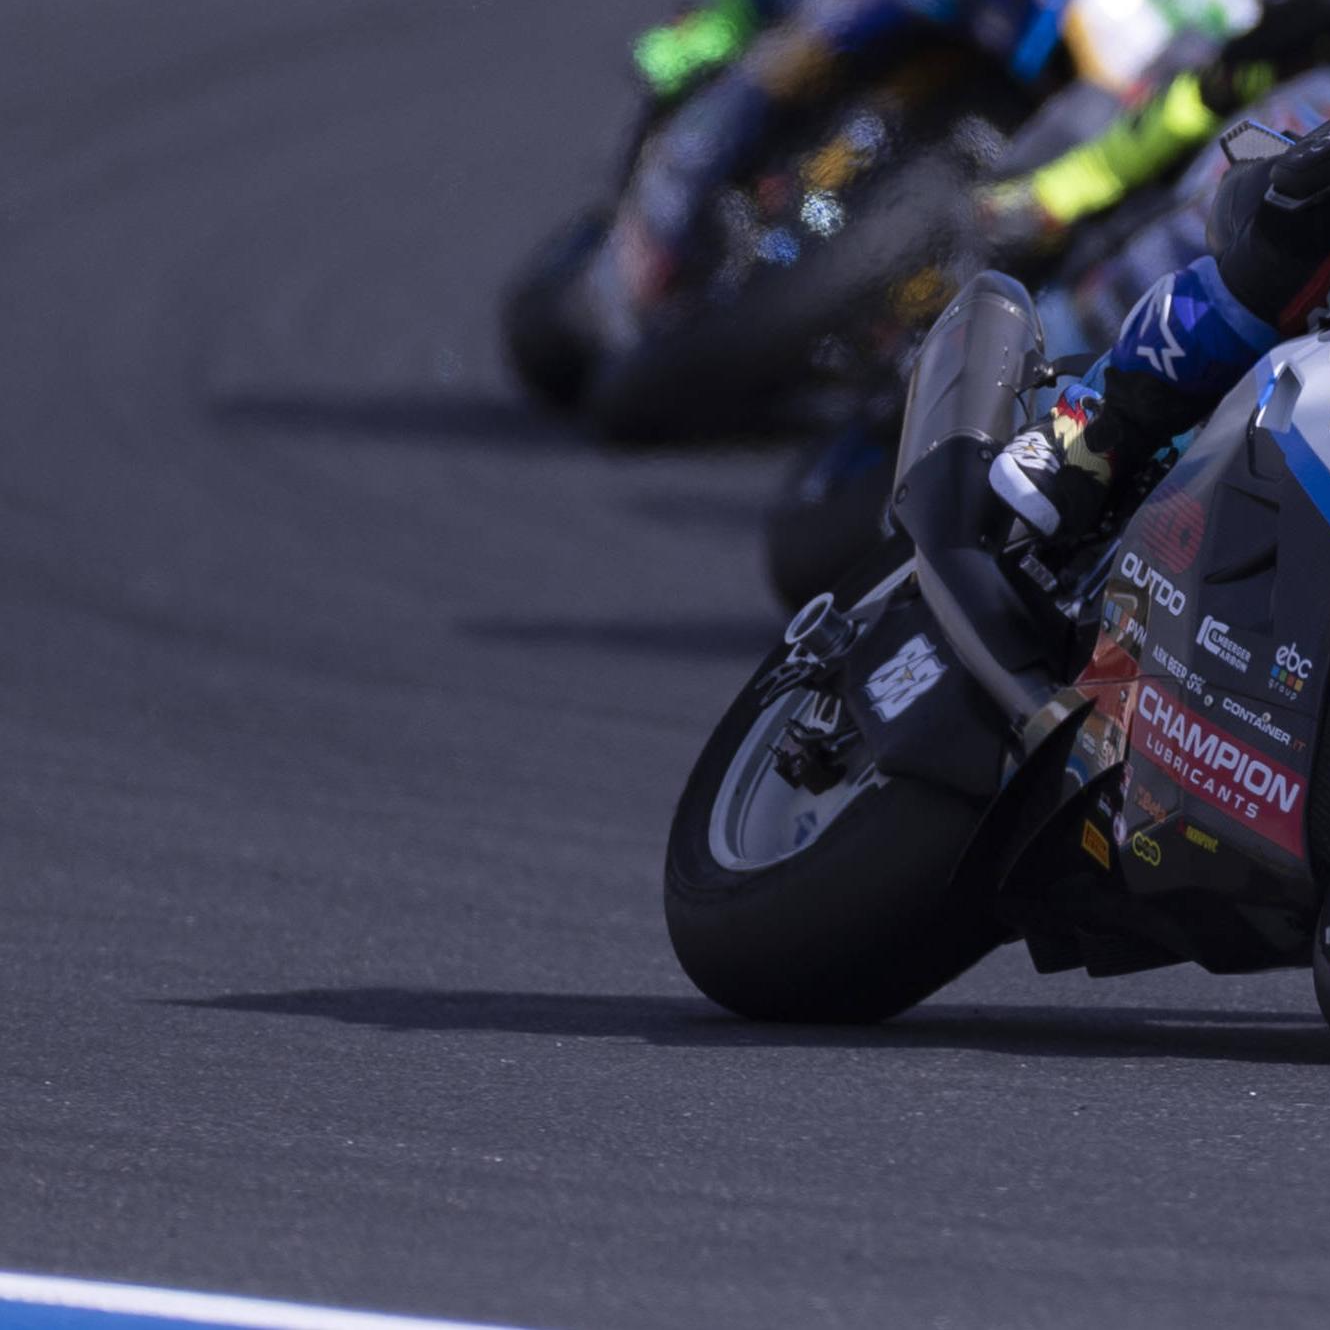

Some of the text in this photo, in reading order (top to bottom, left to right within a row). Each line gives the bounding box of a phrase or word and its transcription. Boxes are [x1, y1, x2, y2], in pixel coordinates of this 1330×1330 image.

[1121, 552, 1186, 616] OUTDO
[1275, 642, 1313, 679] ebc
[1138, 685, 1300, 813] CHAMPION
[1146, 733, 1260, 820] LUBRICANTS
